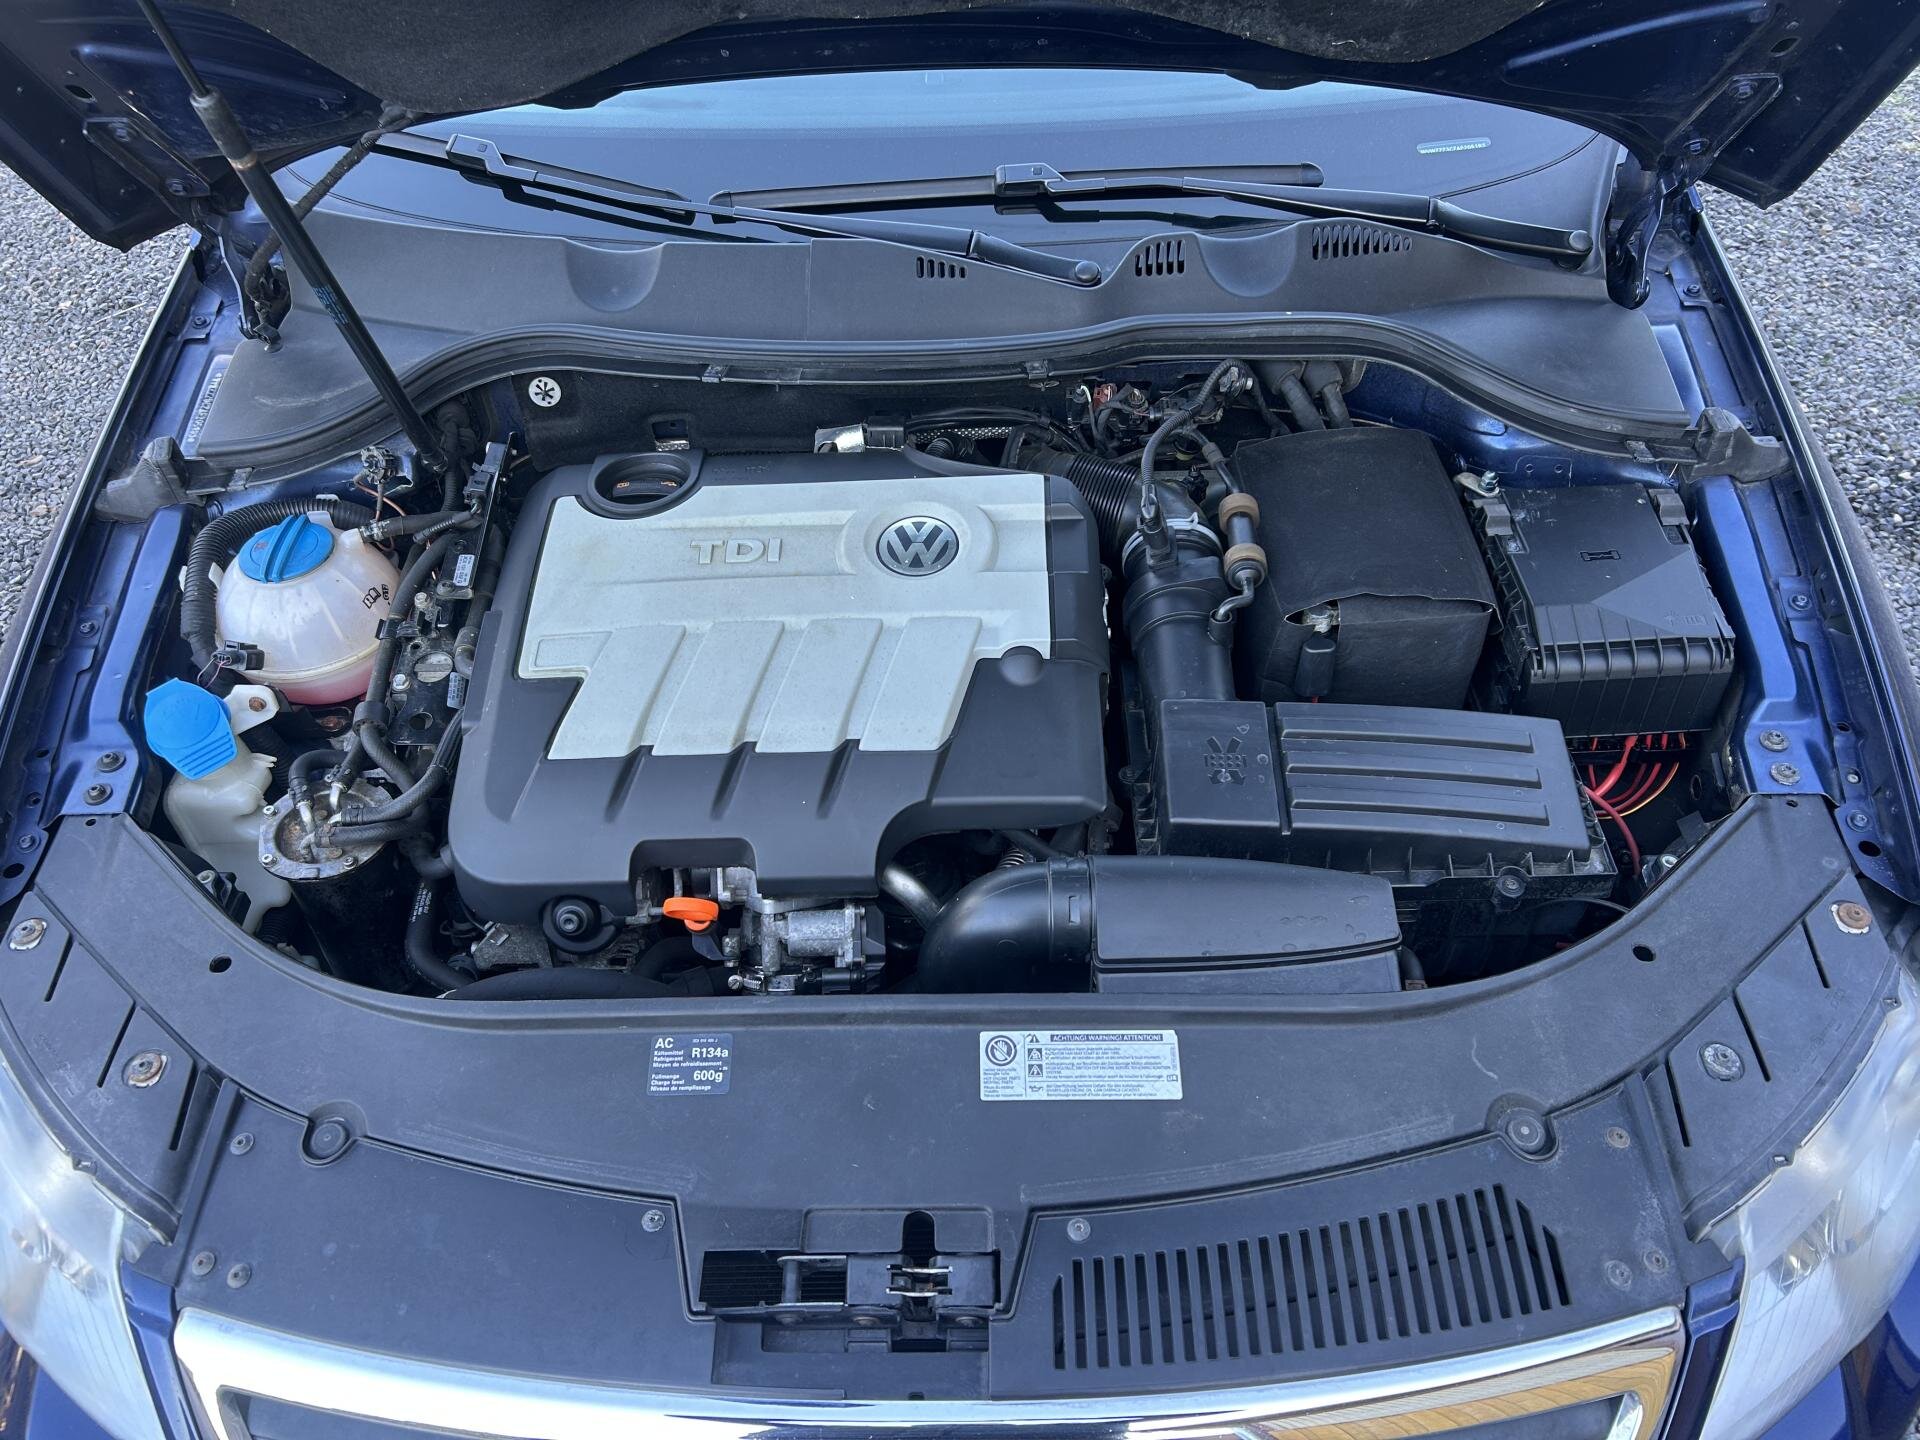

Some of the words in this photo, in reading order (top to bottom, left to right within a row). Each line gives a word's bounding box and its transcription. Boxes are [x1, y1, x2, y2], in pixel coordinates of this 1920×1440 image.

[690, 537, 783, 565] TDI
[880, 518, 955, 573] VW
[655, 1037, 674, 1049] AC
[692, 1047, 729, 1058] R134a
[693, 1070, 723, 1083] 600g
